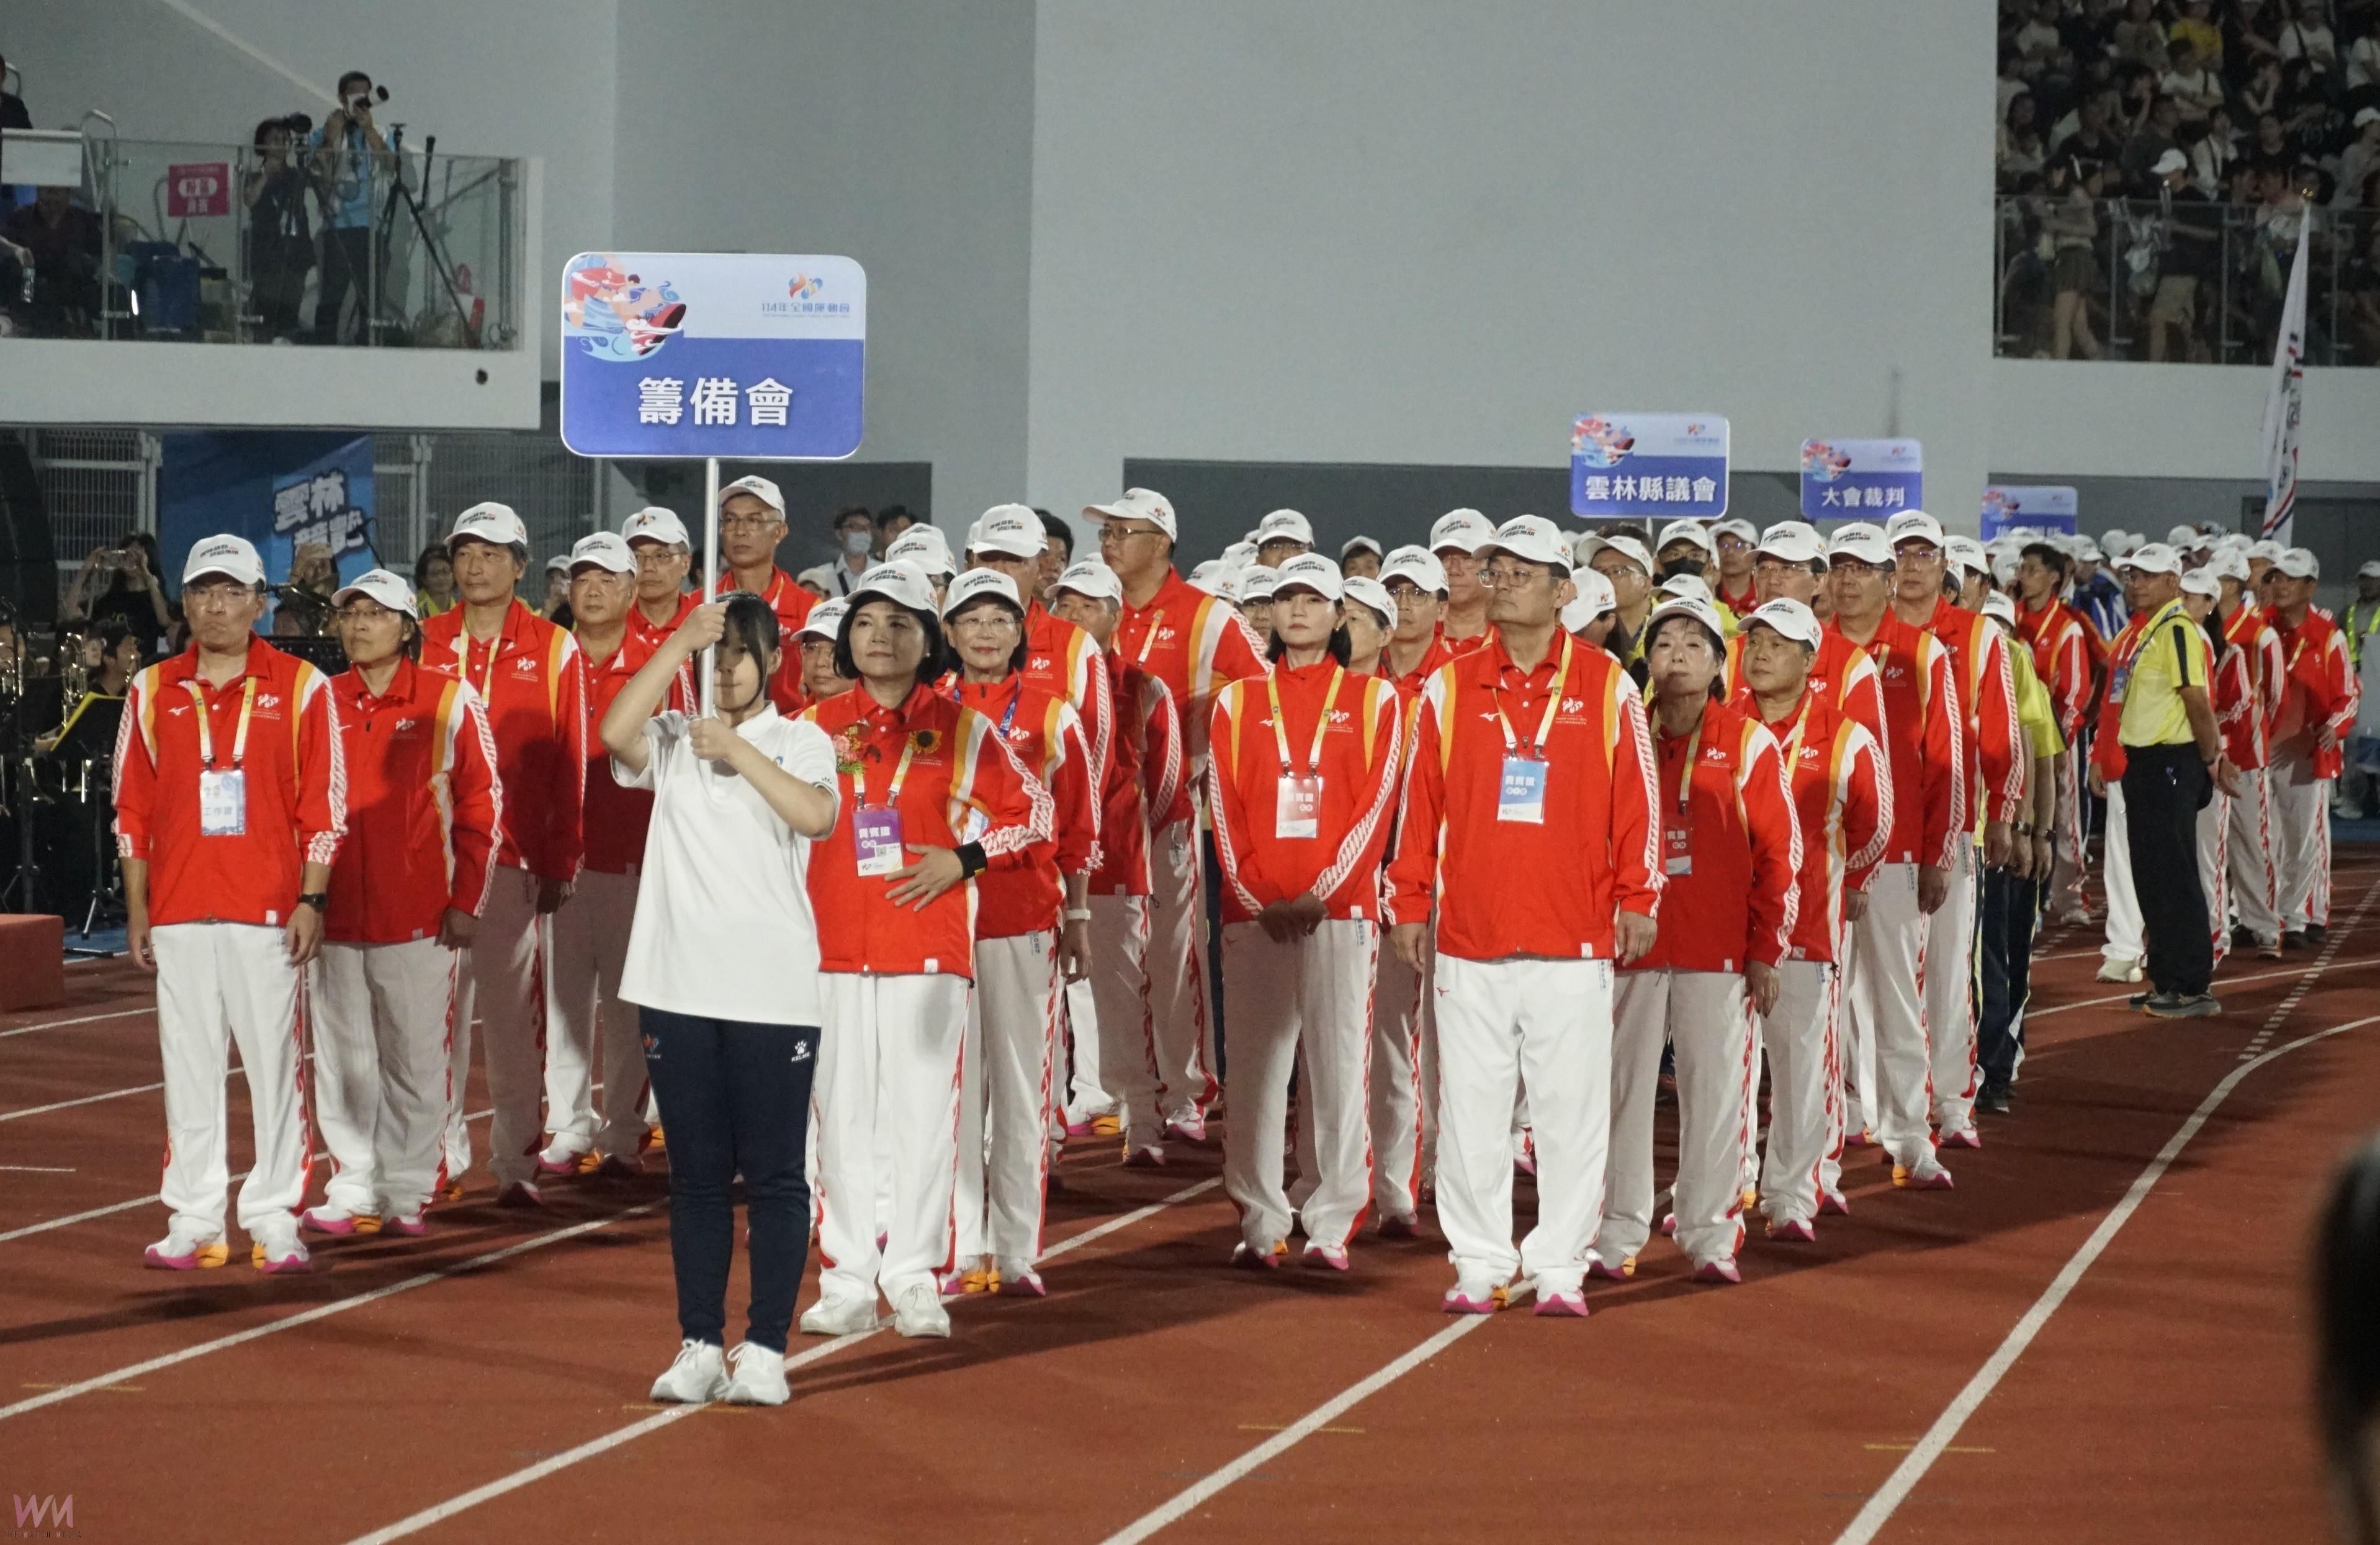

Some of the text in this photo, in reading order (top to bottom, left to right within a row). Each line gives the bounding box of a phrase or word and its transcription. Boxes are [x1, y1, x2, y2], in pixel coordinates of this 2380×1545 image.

[637, 376, 794, 426] 籌備會
[274, 471, 345, 532] 雲林
[1585, 474, 1717, 503] 雲林縣議會
[1821, 486, 1905, 508] 大會裁判
